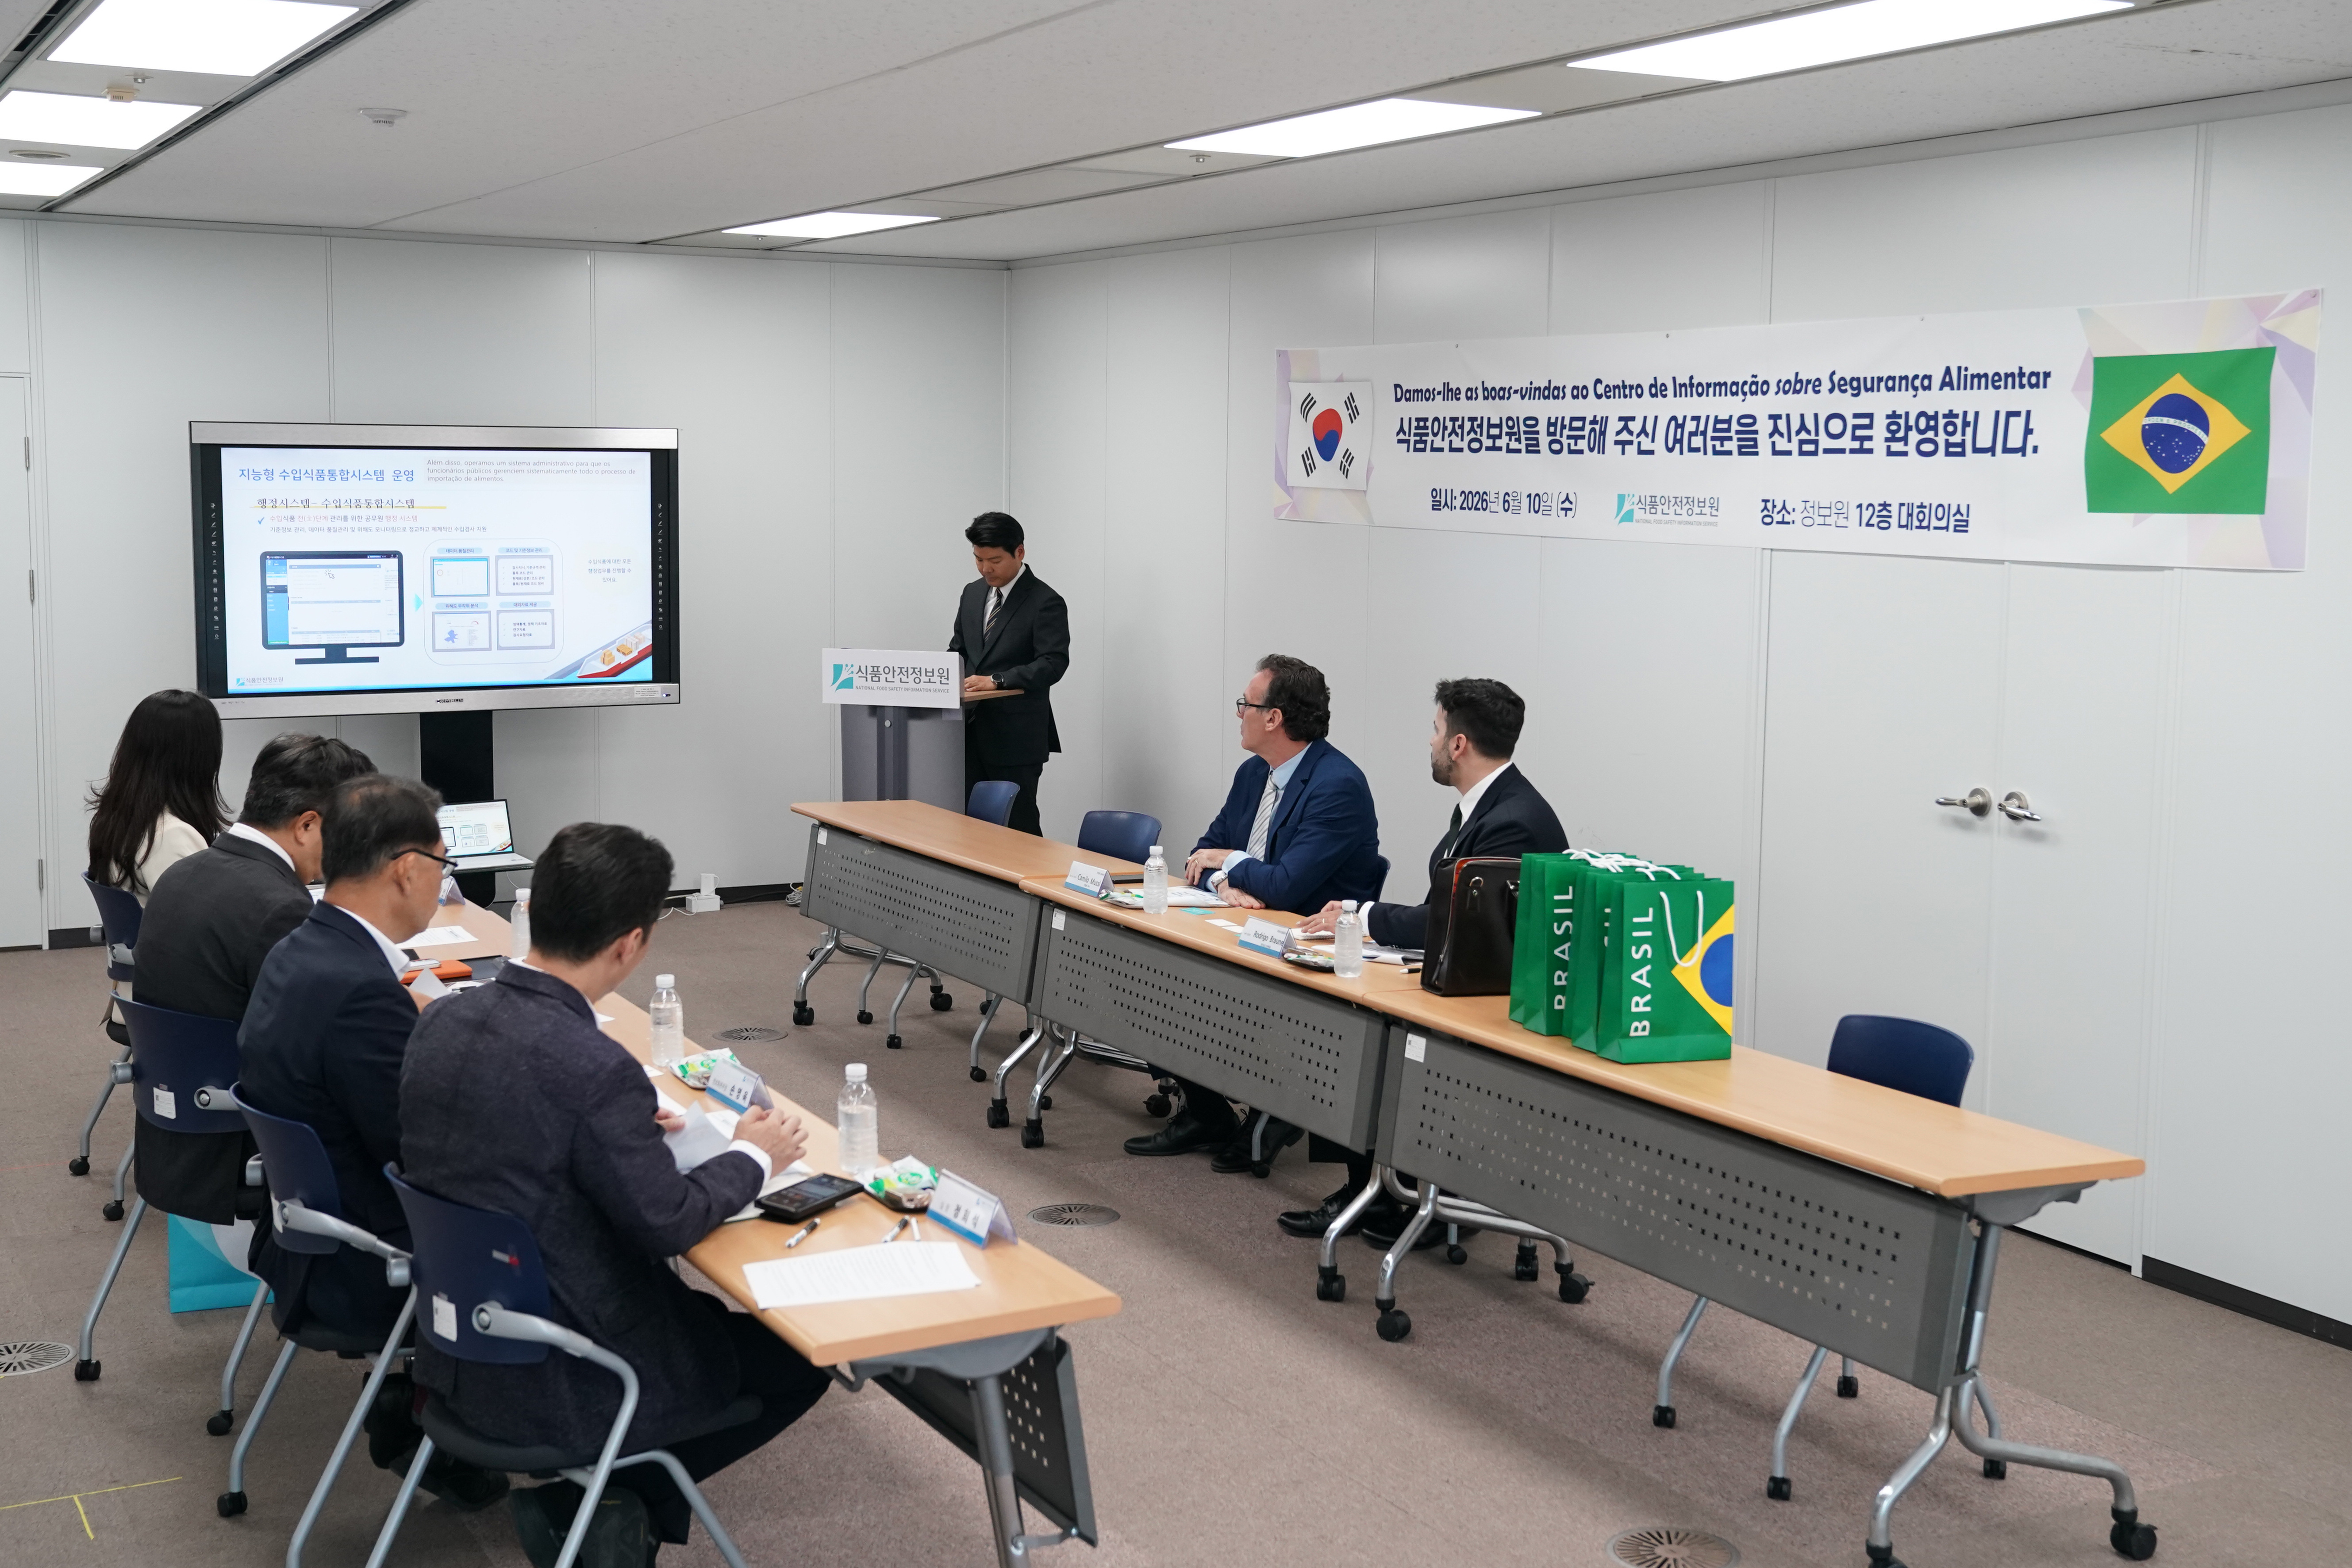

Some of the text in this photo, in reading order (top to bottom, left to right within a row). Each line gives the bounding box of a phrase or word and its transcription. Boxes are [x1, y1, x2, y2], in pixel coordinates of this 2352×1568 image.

[1394, 365, 2051, 402] Damos-lhe as boas-vindas ao Centro de Informação sobre Segurança Alimentar
[1396, 409, 2039, 457] 식품안전정보원을 방문해 주신 여러분을 진심으로 환영합니다.
[239, 468, 415, 482] 지능형 수입식품통합시스템 운영
[321, 498, 415, 509] 수입식품통합시스템
[1431, 488, 1577, 519] 일시: 2026년 6월 10일 (수)
[1636, 495, 1720, 517] 식품안전정보원
[1760, 498, 1971, 533] 장소: 정보원 12층 대회의실
[855, 665, 949, 685] 식품안전정보원
[1077, 873, 1089, 883] Camilo
[1253, 930, 1269, 942] Rodrigo
[1629, 907, 1653, 1037] BRASIL
